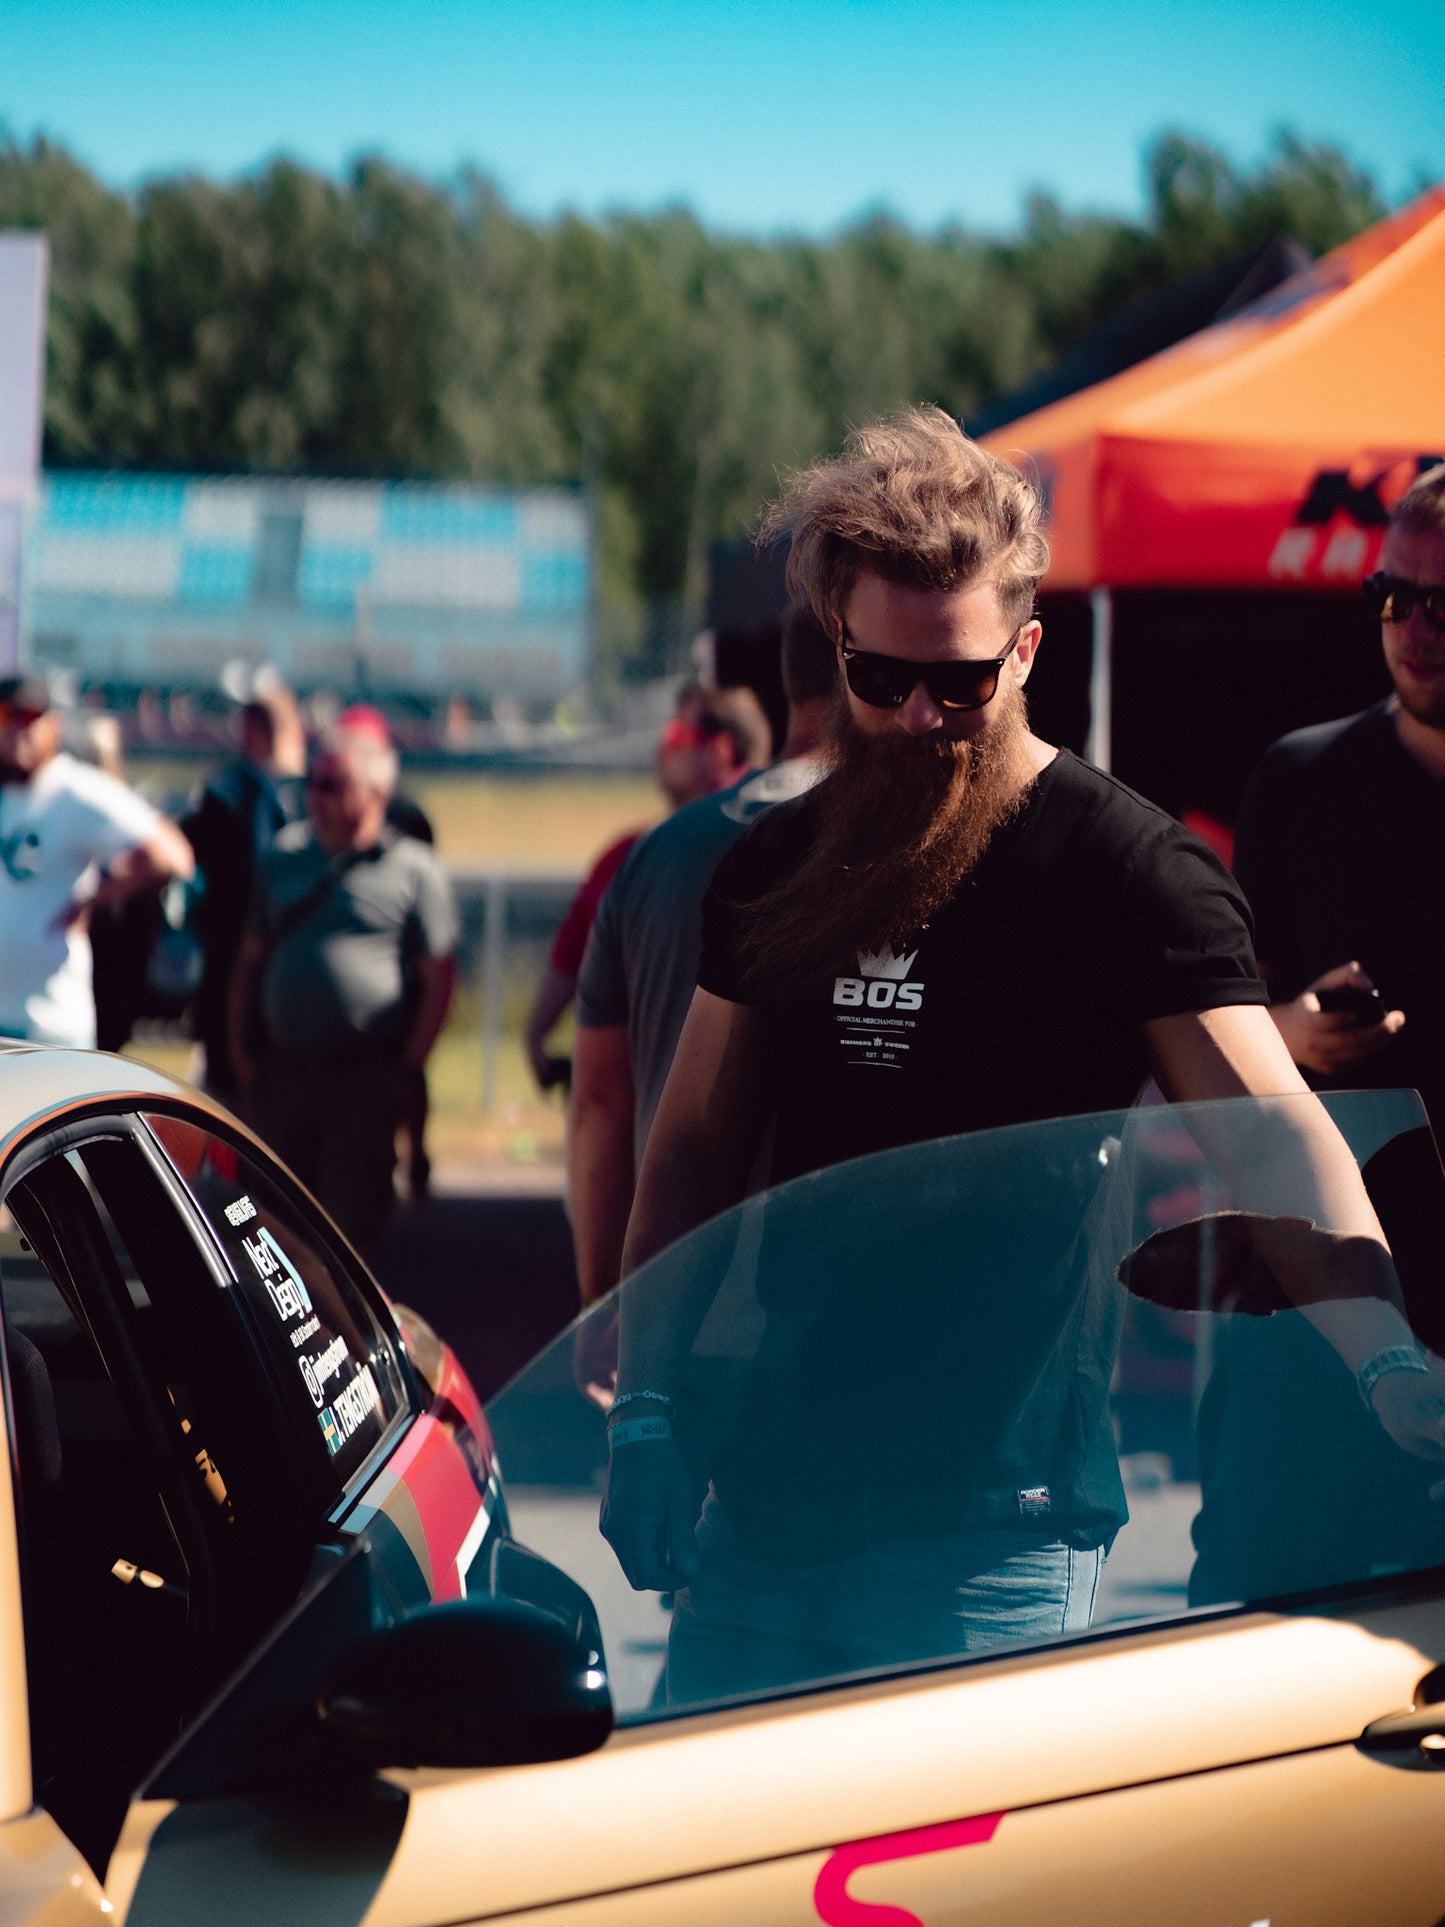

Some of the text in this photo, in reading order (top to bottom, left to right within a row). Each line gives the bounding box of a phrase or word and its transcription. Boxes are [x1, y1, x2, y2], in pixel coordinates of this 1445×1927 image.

[833, 977, 925, 1011] BOS
[836, 1015, 916, 1028] OFFICIAL MERCHANDISE FOR
[241, 1231, 280, 1280] Next
